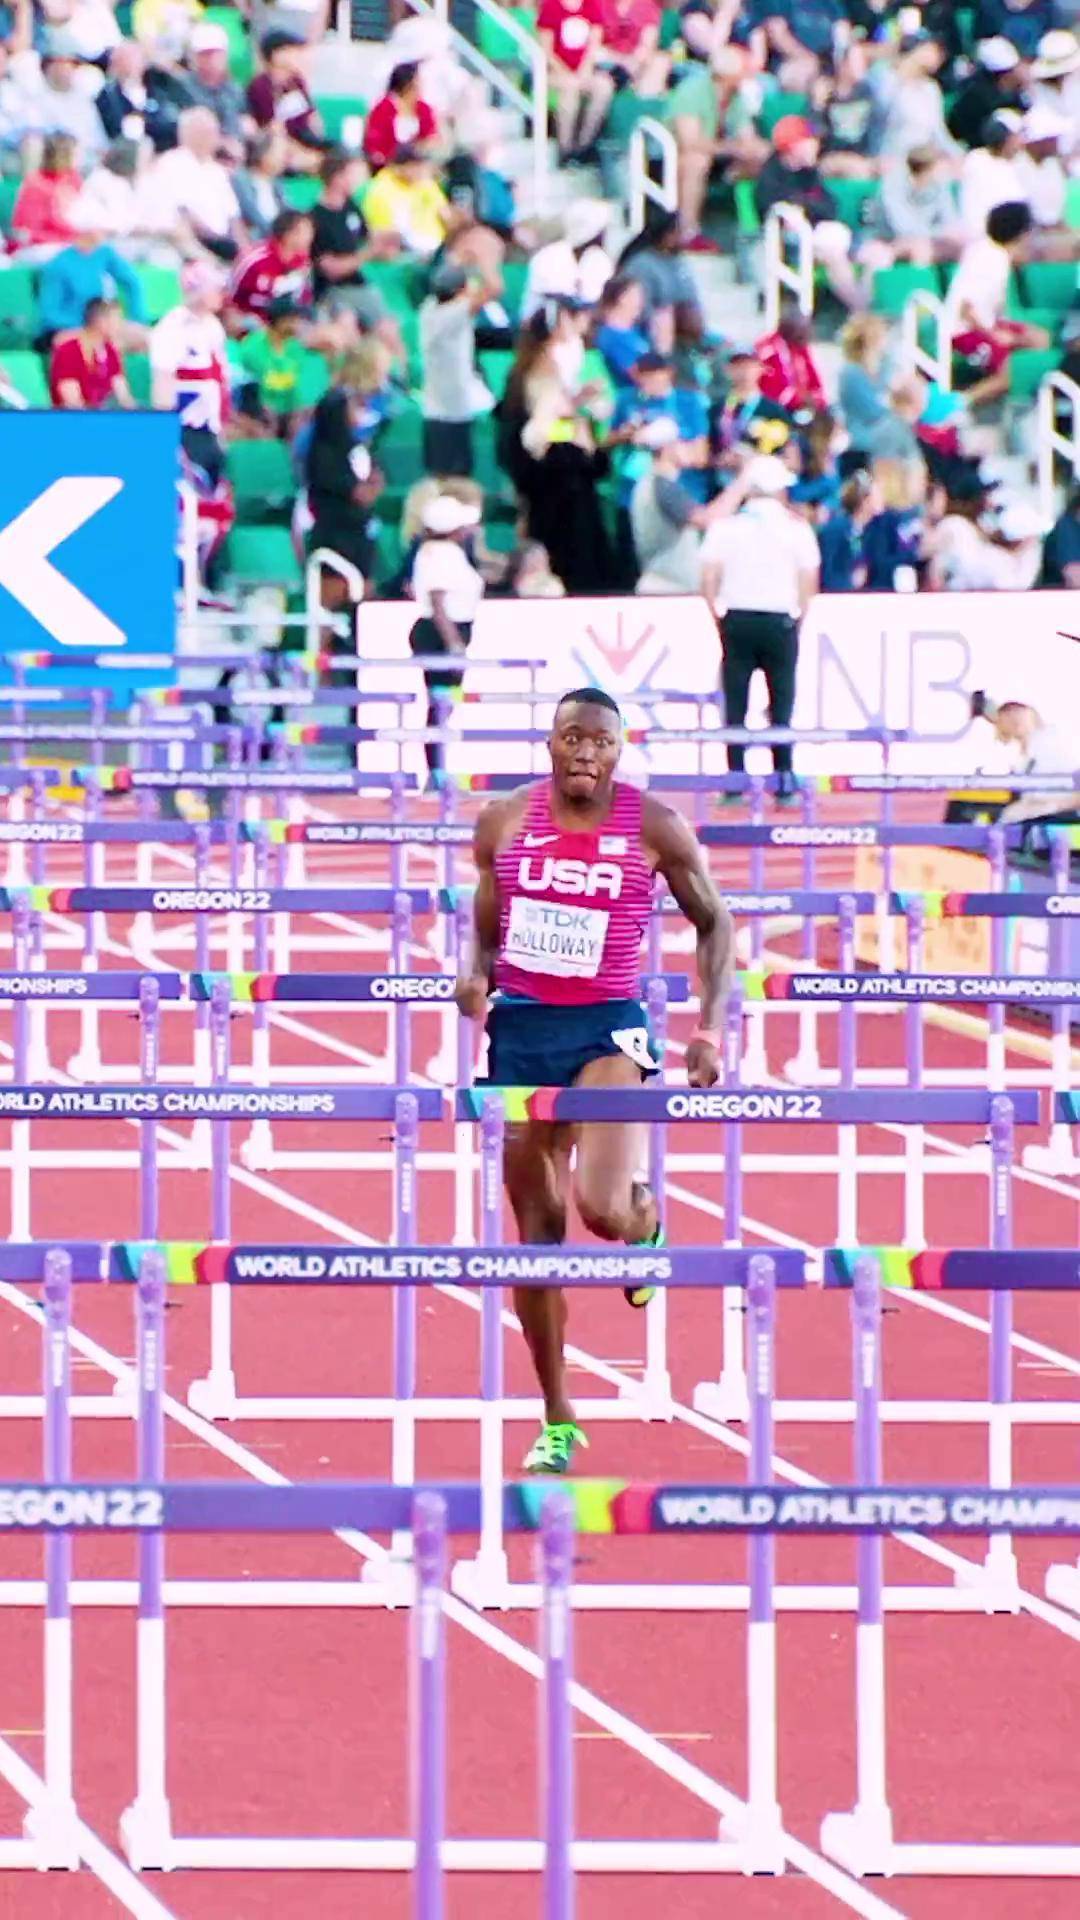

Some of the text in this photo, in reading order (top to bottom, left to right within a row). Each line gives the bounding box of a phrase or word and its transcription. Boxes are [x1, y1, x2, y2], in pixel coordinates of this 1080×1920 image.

[518, 856, 624, 900] USA
[153, 891, 271, 910] OREGON22
[511, 927, 599, 957] HOLLOWAY
[793, 978, 857, 994] WORLD
[859, 978, 956, 996] ATHLETICS
[48, 1092, 158, 1112] ATHLETICS
[162, 1093, 335, 1113] CHAMPIONSHIPS
[666, 1095, 823, 1118] OREGON22
[234, 1255, 673, 1279] WORLD ATHLETICS CHAMPIONSHIPS
[660, 1495, 776, 1525] WORLD
[778, 1495, 946, 1526] ATHLETICS
